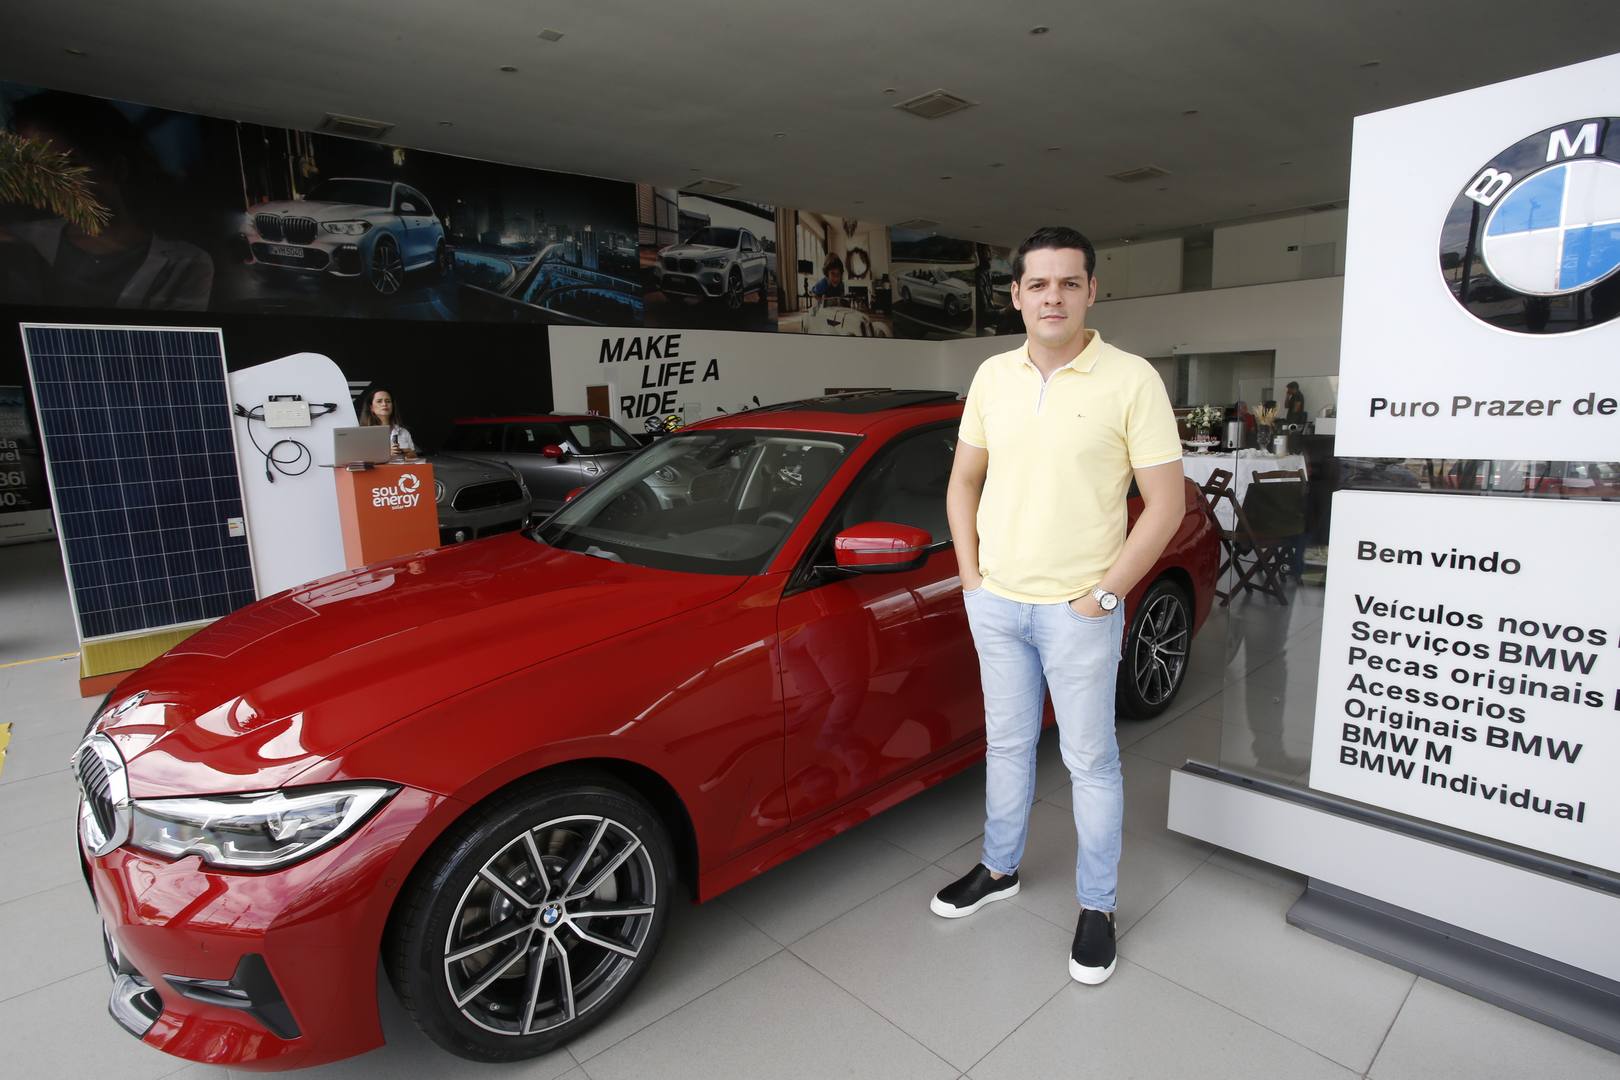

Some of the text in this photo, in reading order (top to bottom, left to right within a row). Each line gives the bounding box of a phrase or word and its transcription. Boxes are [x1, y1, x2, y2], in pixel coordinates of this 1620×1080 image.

[598, 333, 682, 364] MAKE
[641, 358, 720, 389] LIFE A
[620, 390, 685, 420] RIDE.
[1369, 393, 1618, 418] Puro Prazer de
[372, 486, 398, 498] sou
[372, 493, 420, 508] energy
[1357, 541, 1521, 575] Bem vindo
[1354, 594, 1484, 630] Veículos
[1498, 617, 1608, 647] novos
[1351, 621, 1599, 675] Serviços BMW
[1348, 647, 1439, 680] Pecas
[1450, 669, 1604, 708] originais
[1346, 674, 1526, 724] Acessorios
[1342, 723, 1453, 765] BMW M
[1344, 699, 1584, 764] Originais BMW
[1339, 746, 1586, 824] BMW Individual
